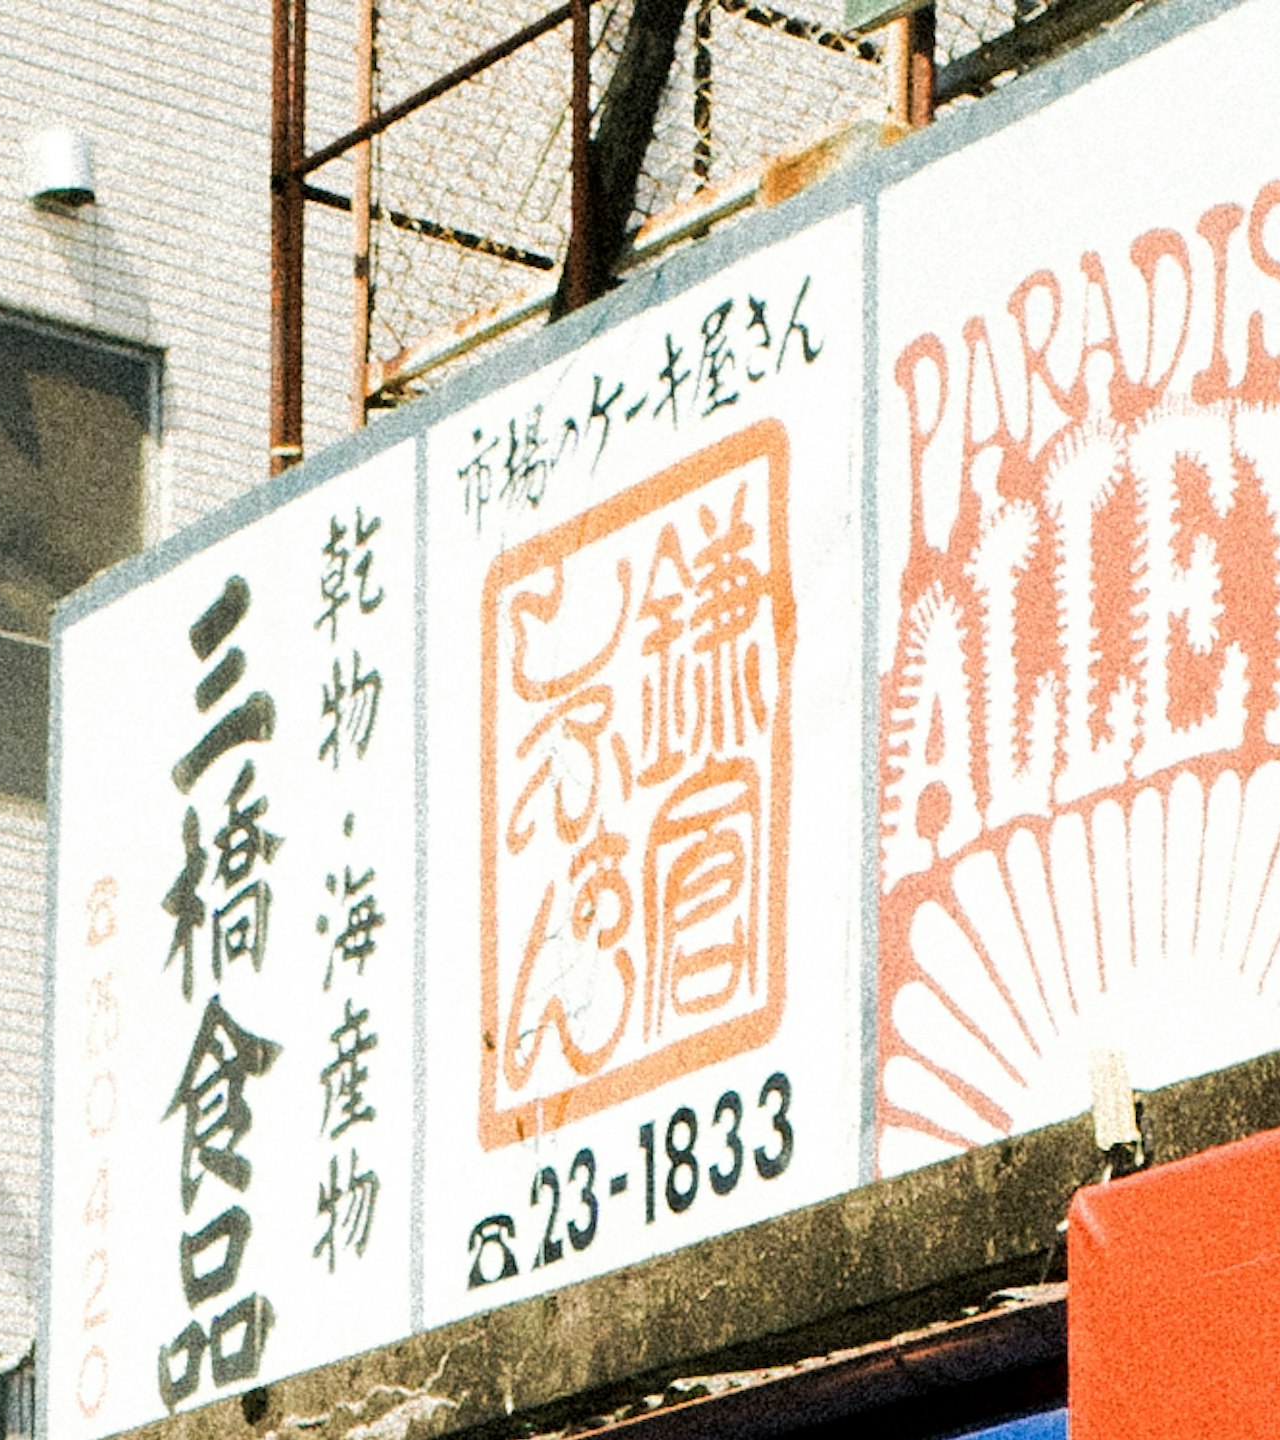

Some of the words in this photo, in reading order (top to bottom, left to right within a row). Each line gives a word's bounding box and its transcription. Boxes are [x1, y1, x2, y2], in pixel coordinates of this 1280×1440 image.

[456, 275, 826, 536] 市場のケーキ屋さん
[158, 573, 285, 1413] 三橋食品
[312, 506, 387, 1273] 乾物・海産物
[634, 480, 774, 1044] 鎌倉
[527, 1071, 797, 1271] 23-1833
